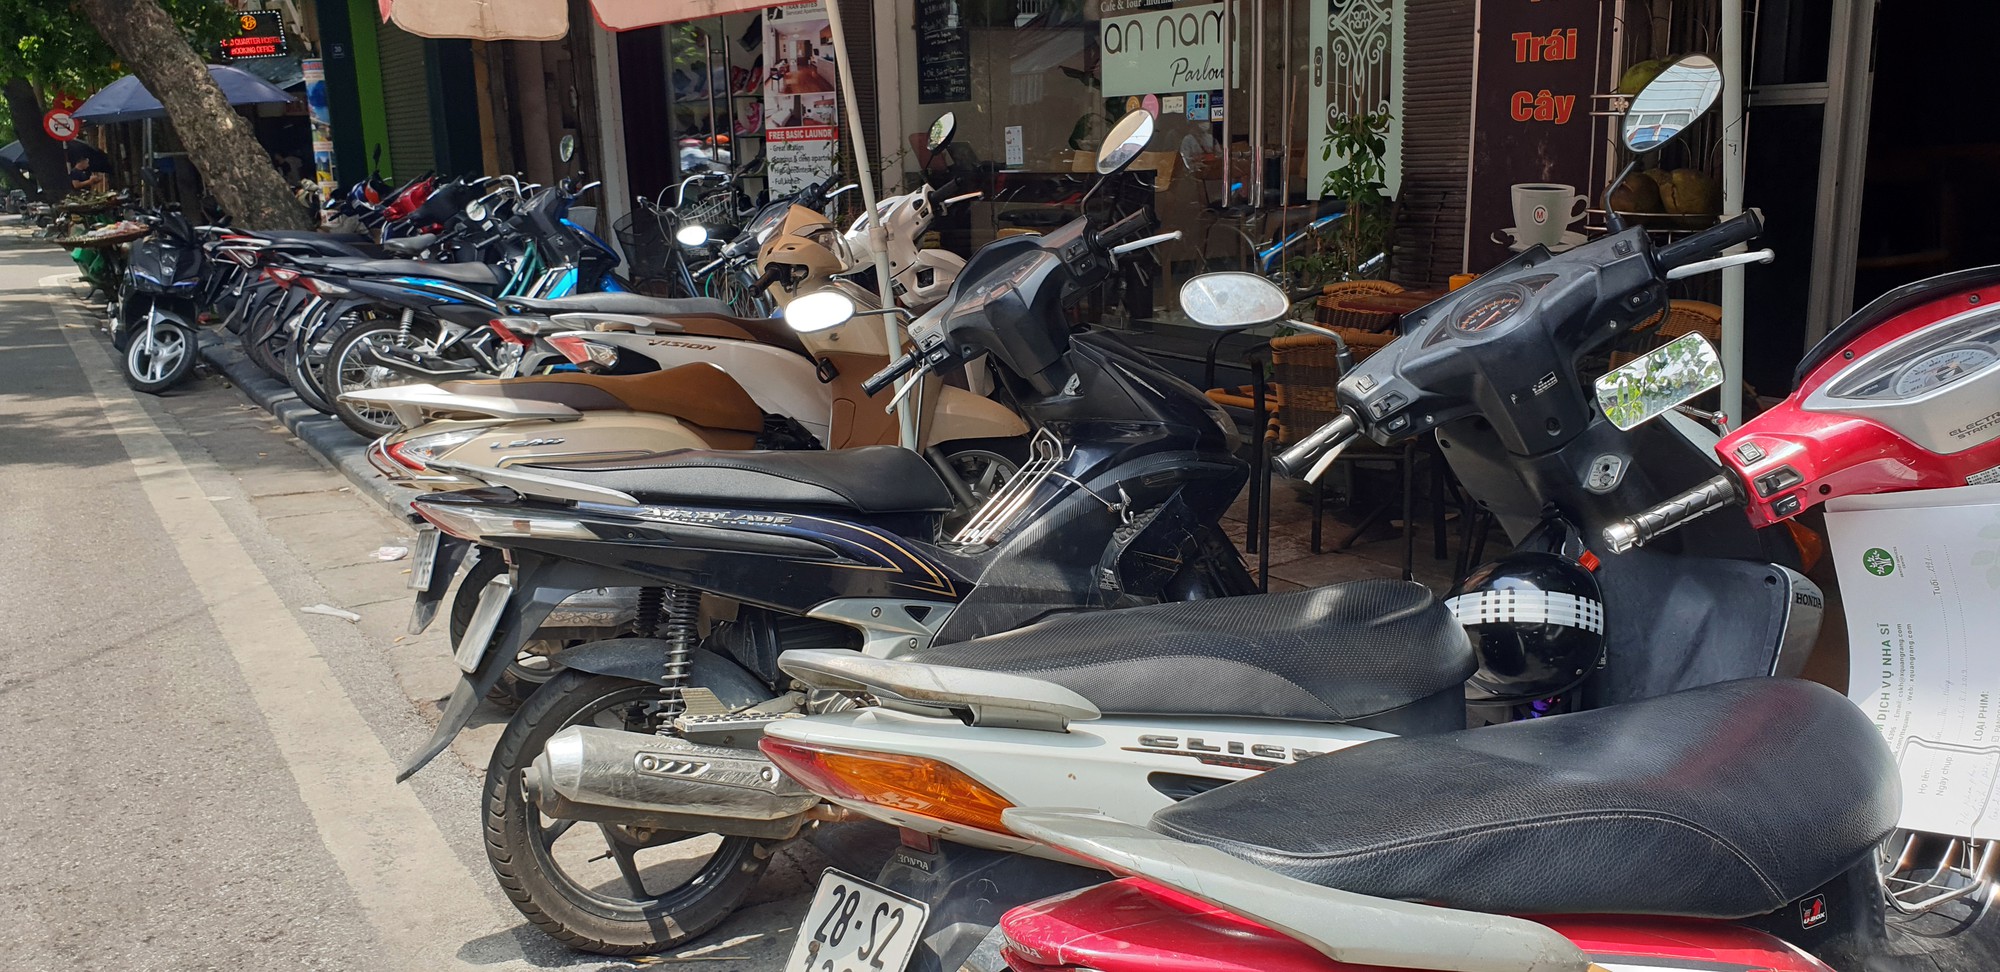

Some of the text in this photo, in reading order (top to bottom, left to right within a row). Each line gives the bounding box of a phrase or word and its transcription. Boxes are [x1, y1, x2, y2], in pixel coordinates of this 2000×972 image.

[1101, 2, 1116, 12] Cafe
[1117, 1, 1125, 10] &
[1105, 10, 1236, 54] an nam
[256, 45, 275, 53] OFFICE
[1512, 28, 1577, 62] Trái
[1170, 54, 1233, 87] Parlou
[1213, 109, 1224, 117] VIS
[1511, 89, 1575, 124] Cây
[768, 128, 833, 139] FREE BASIC LAUNDR
[646, 338, 717, 351] VISION
[1796, 592, 1822, 609] HONDA
[1882, 640, 1892, 666] NHA
[1906, 623, 1917, 682] xquangrang.com
[1882, 670, 1894, 689] VỤ
[1877, 693, 1890, 721] DỊCH
[1972, 721, 1987, 741] LOẠI
[1804, 912, 1826, 925] U-BOX
